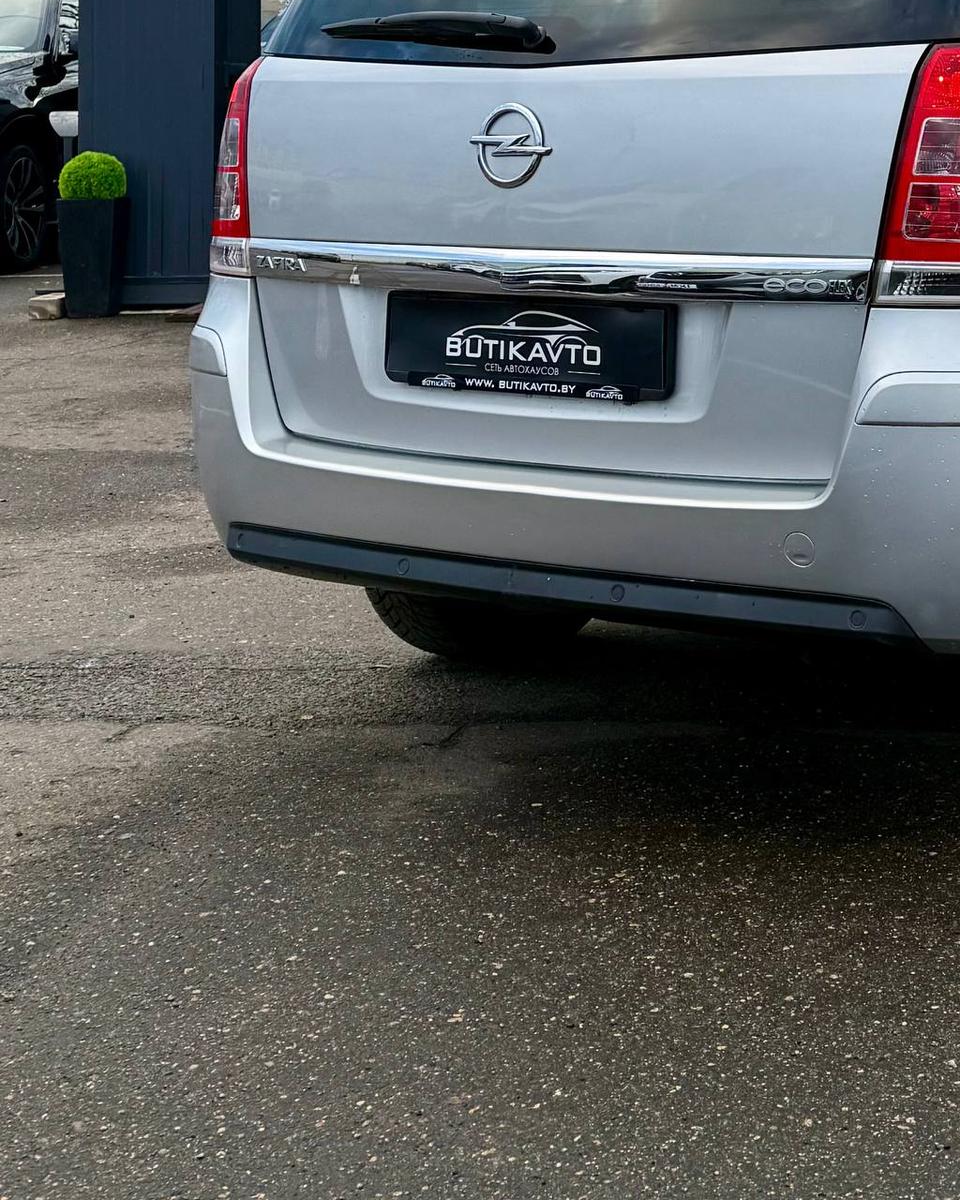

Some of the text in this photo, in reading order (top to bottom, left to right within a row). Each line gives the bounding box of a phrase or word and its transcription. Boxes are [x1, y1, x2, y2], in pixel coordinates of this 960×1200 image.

[256, 255, 307, 271] ZAFIRA
[445, 337, 601, 366] BUTIKAVTO
[484, 362, 560, 376] СЕТЬ АВТОХАУСОВ
[498, 380, 577, 394] BUTIKAVTO.BY
